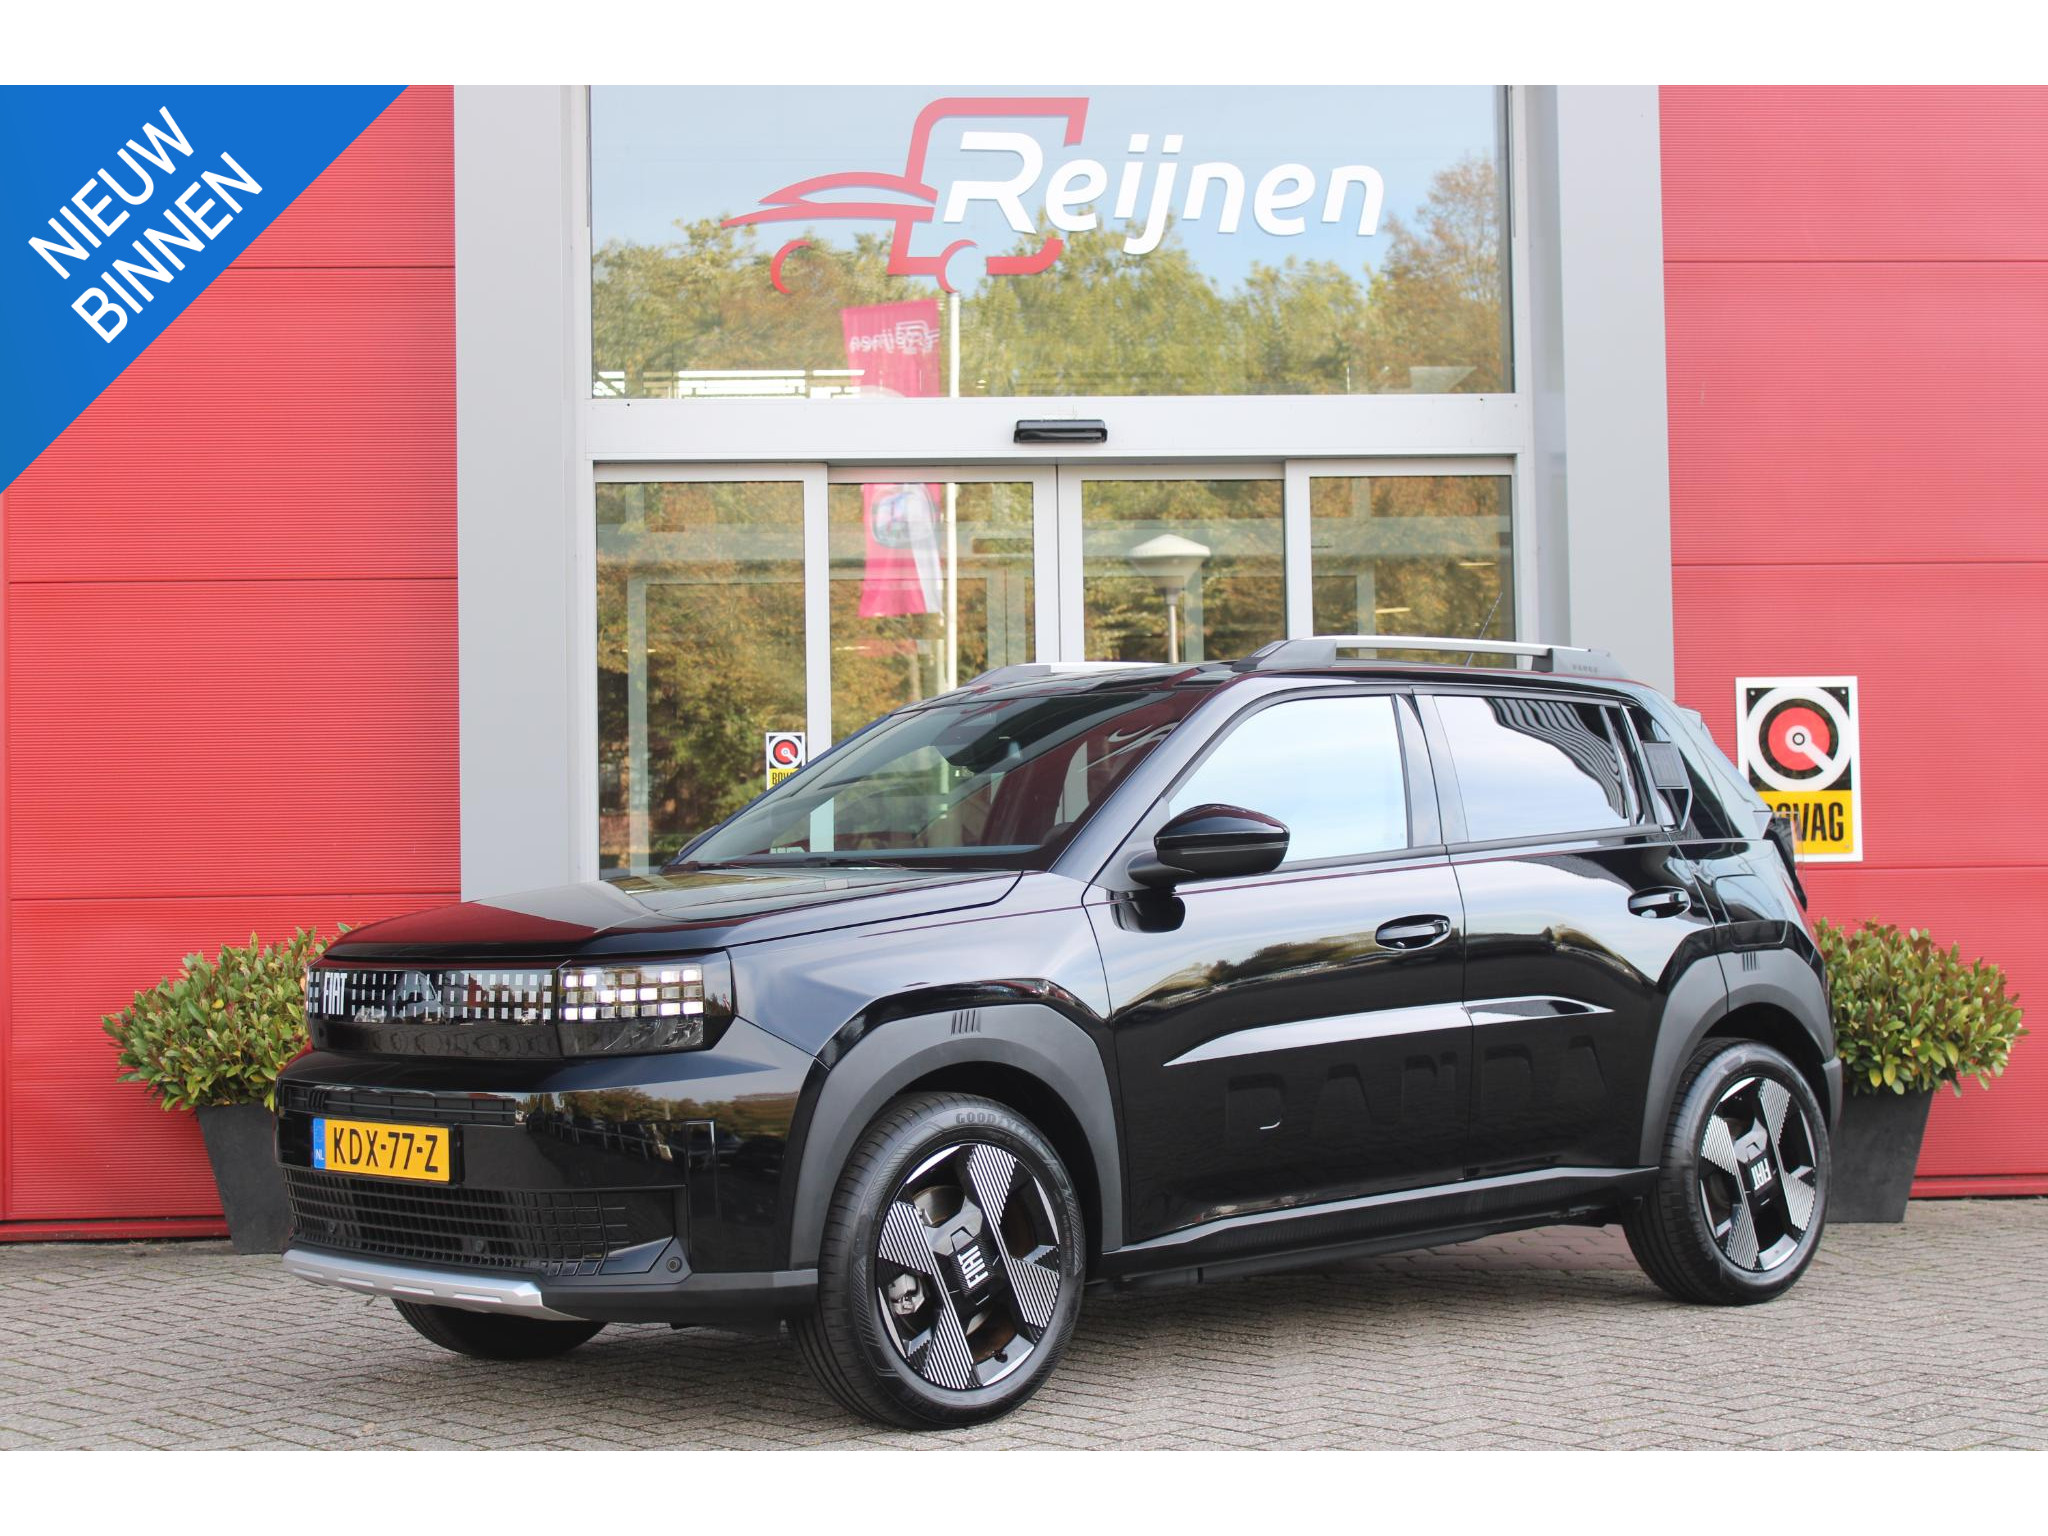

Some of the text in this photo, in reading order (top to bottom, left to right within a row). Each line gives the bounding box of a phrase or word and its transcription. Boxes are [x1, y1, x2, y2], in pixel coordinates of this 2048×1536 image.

[943, 131, 1385, 255] Reijnen
[1767, 802, 1844, 842] VAG
[323, 971, 348, 1015] FIAT
[315, 1148, 325, 1161] NL
[333, 1127, 439, 1173] KDX-77-Z
[1751, 1157, 1772, 1190] FIAT
[957, 1244, 989, 1288] FIAT
